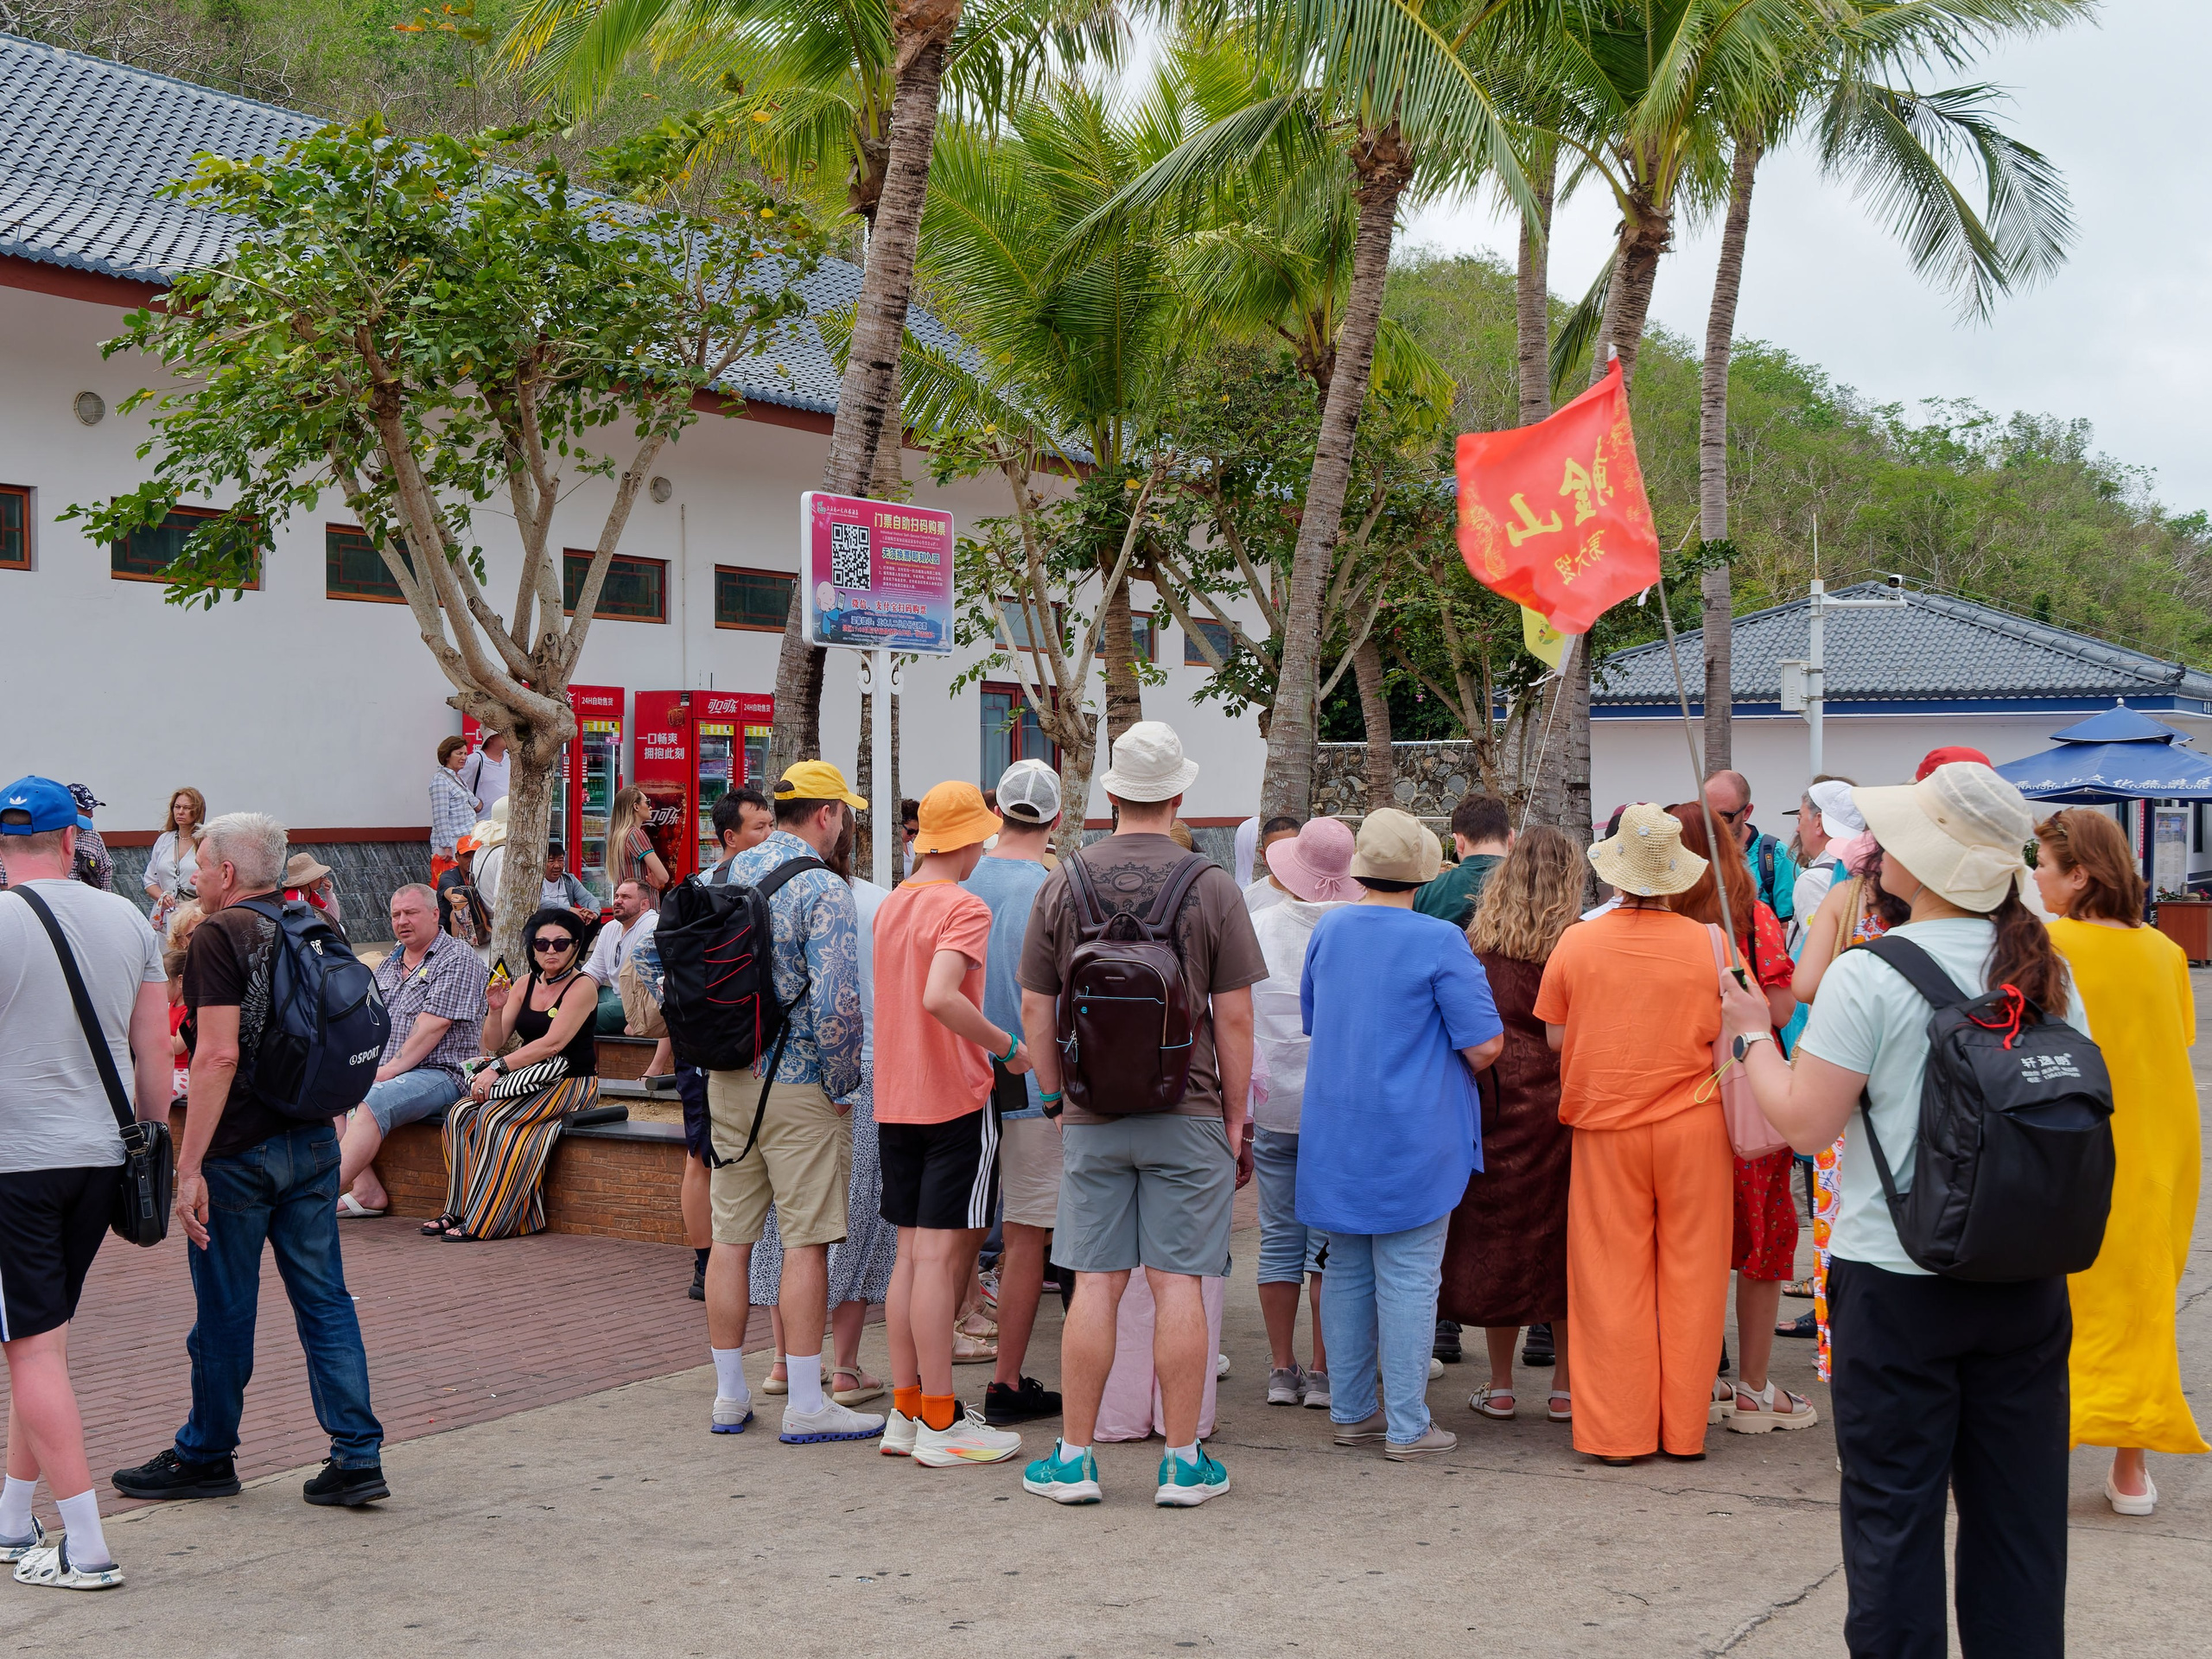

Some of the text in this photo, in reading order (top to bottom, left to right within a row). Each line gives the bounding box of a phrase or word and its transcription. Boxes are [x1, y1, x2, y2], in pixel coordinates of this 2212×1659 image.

[874, 512, 946, 537] 门票自助扫码购票
[581, 696, 614, 707] 24H自助售货
[707, 698, 740, 715] 可口可乐
[743, 703, 772, 713] 24H自助售货
[637, 733, 678, 745] 一口畅爽
[644, 747, 685, 760] 拥抱此刻
[641, 806, 683, 827] 口可乐
[357, 1045, 380, 1065] SPORT
